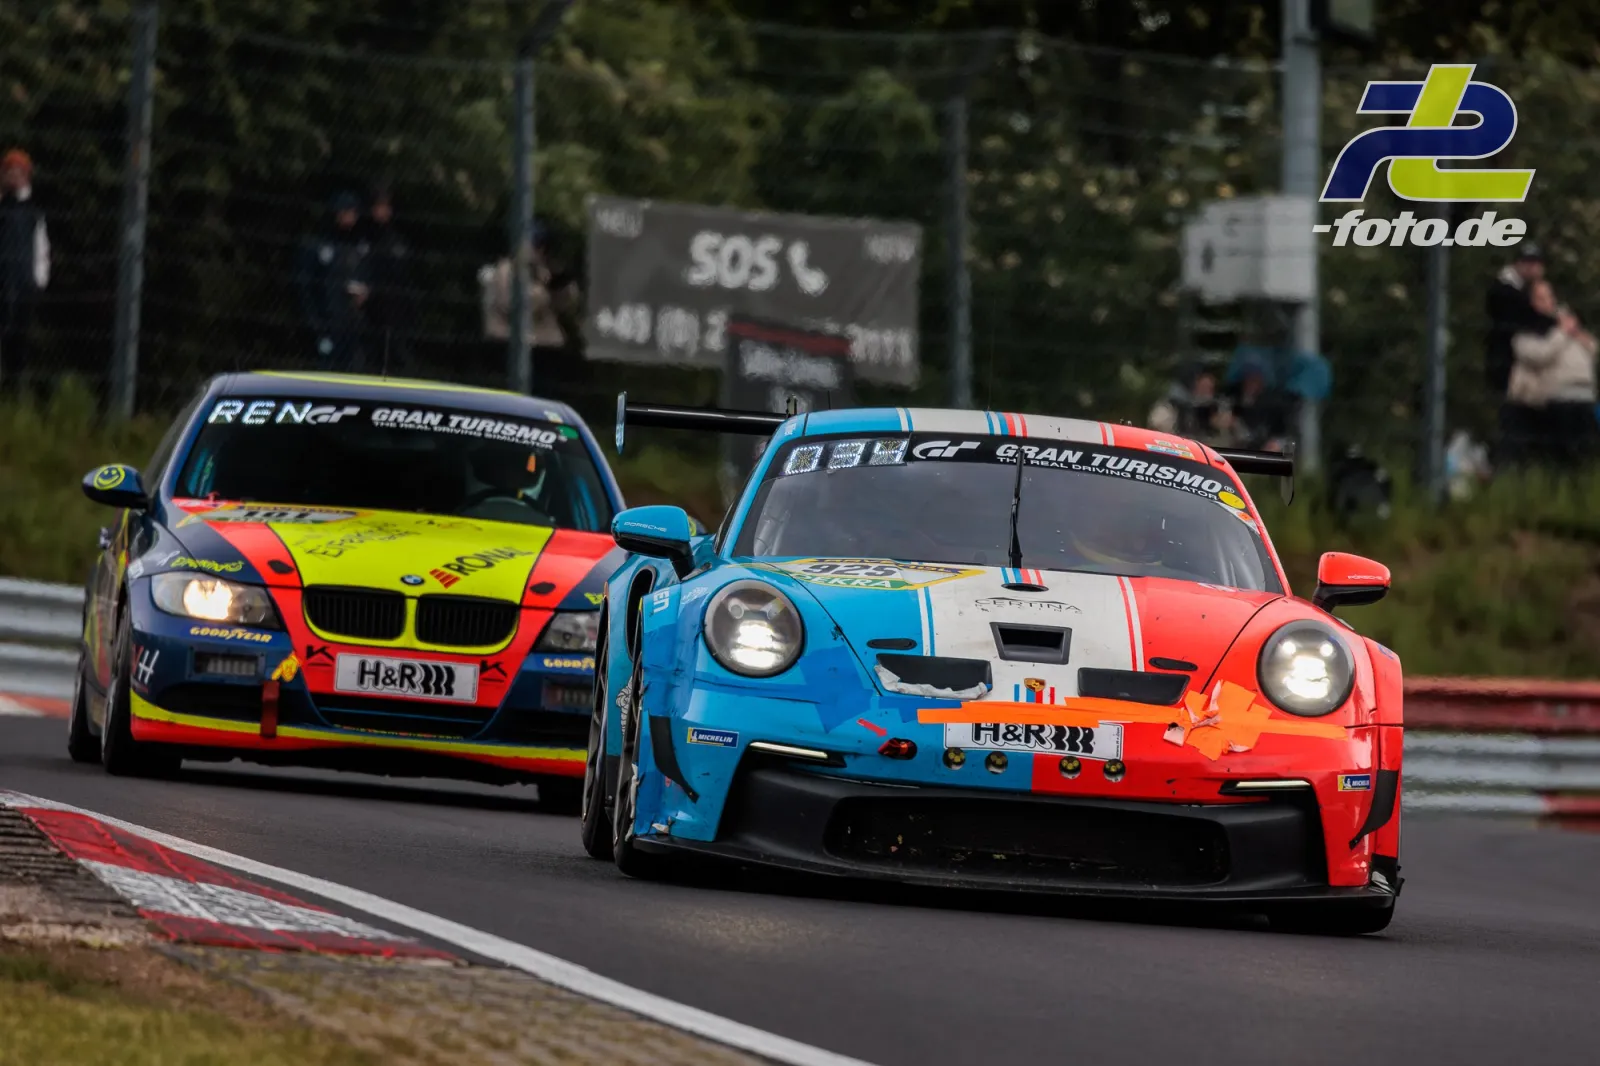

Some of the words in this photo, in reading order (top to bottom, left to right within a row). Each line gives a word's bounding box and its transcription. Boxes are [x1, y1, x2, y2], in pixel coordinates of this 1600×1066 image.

[687, 230, 783, 291] SOS
[207, 399, 312, 425] REN
[371, 407, 443, 426] GRAN
[373, 421, 397, 429] THE
[400, 423, 431, 431] REAL
[432, 426, 482, 438] DRIVING
[484, 432, 553, 449] SIMULATOR
[995, 443, 1084, 464] GRAN
[1033, 459, 1068, 470] REAL
[1072, 464, 1132, 479] DRIVING
[1135, 474, 1219, 501] SIMULATOR
[624, 521, 667, 532] PORSCHE
[802, 563, 898, 577] 925
[975, 599, 1082, 612] CERTINA
[189, 626, 273, 643] GOODYEAR
[357, 658, 421, 692] H&R
[698, 733, 733, 743] MICHELIN
[972, 723, 1052, 749] H&R
